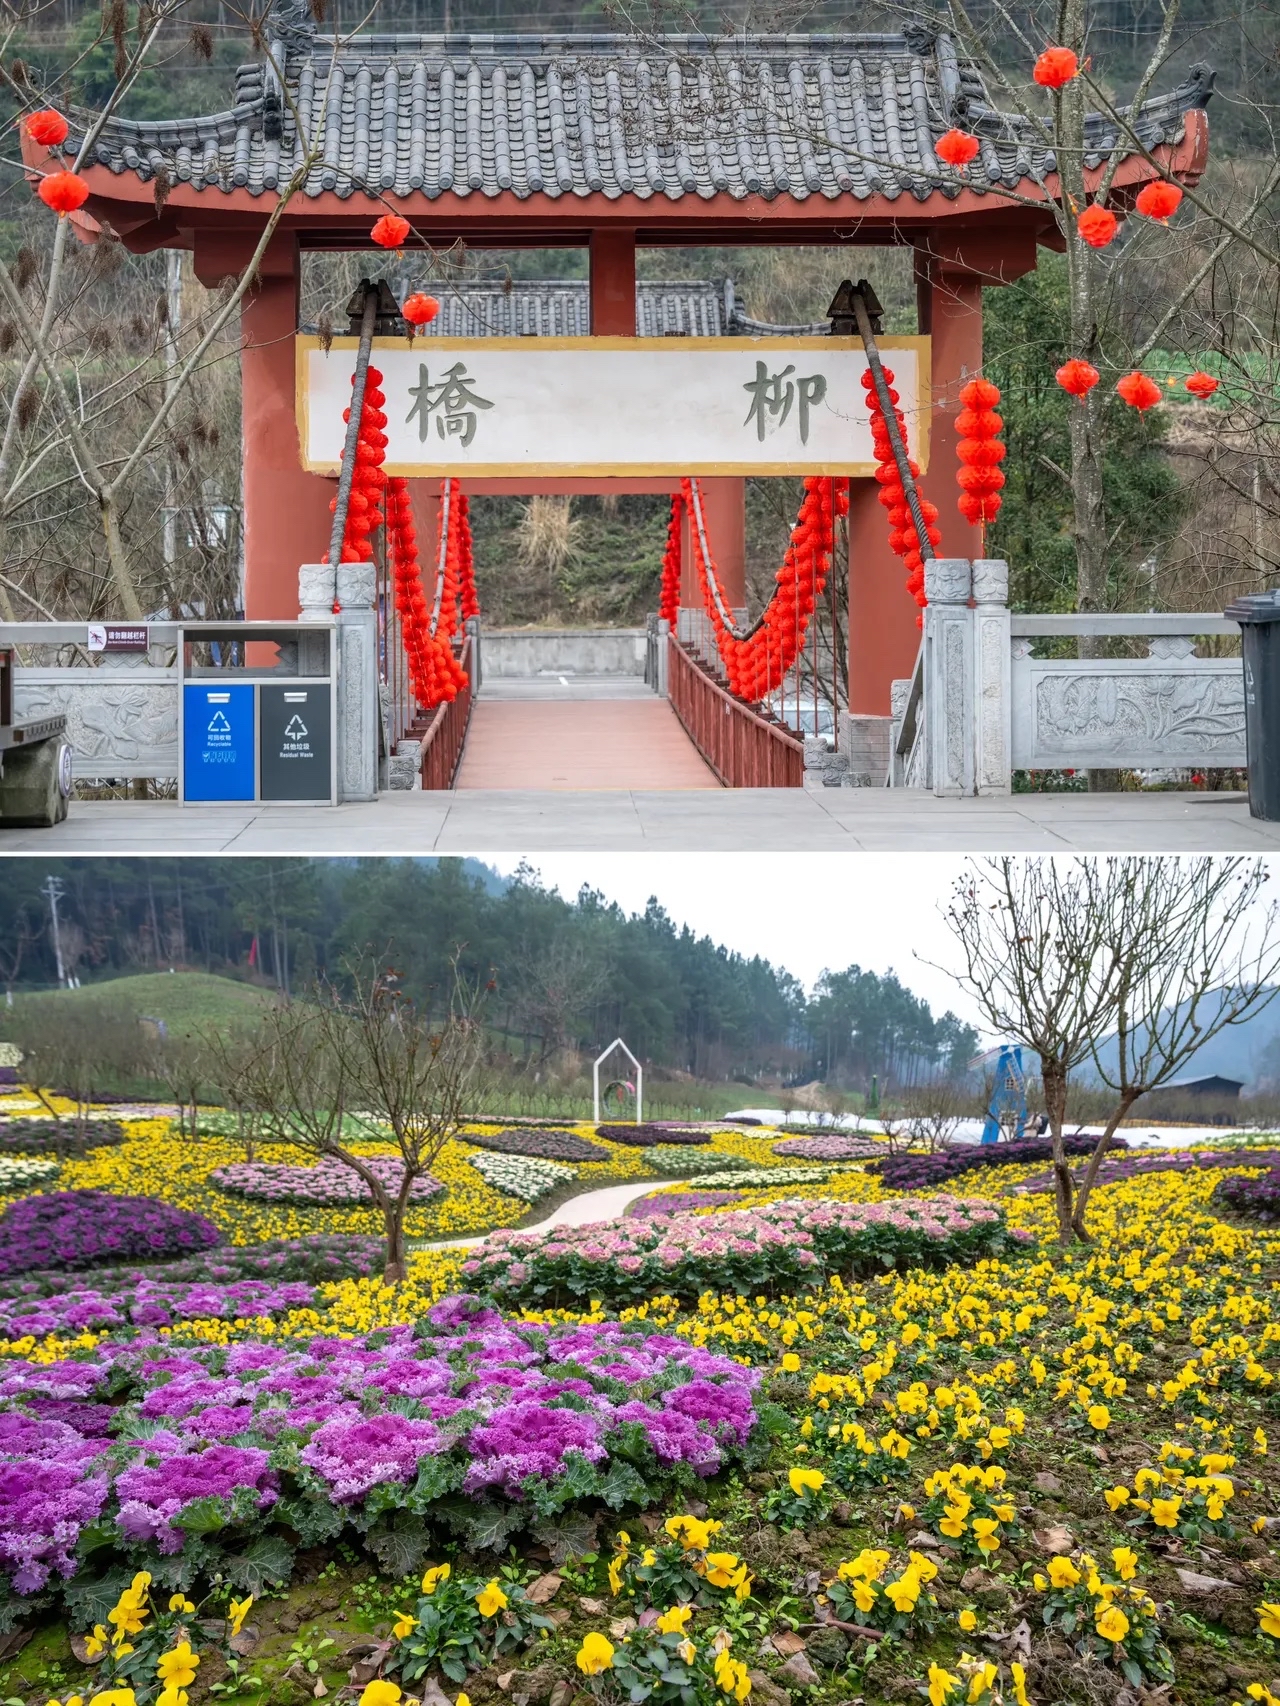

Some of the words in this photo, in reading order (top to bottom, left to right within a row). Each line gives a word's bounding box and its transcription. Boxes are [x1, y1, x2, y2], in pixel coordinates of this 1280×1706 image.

[405, 361, 495, 448] 橋
[743, 360, 827, 447] 柳
[108, 631, 146, 639] 请勿翻越栏杆
[283, 742, 310, 750] 其他垃圾
